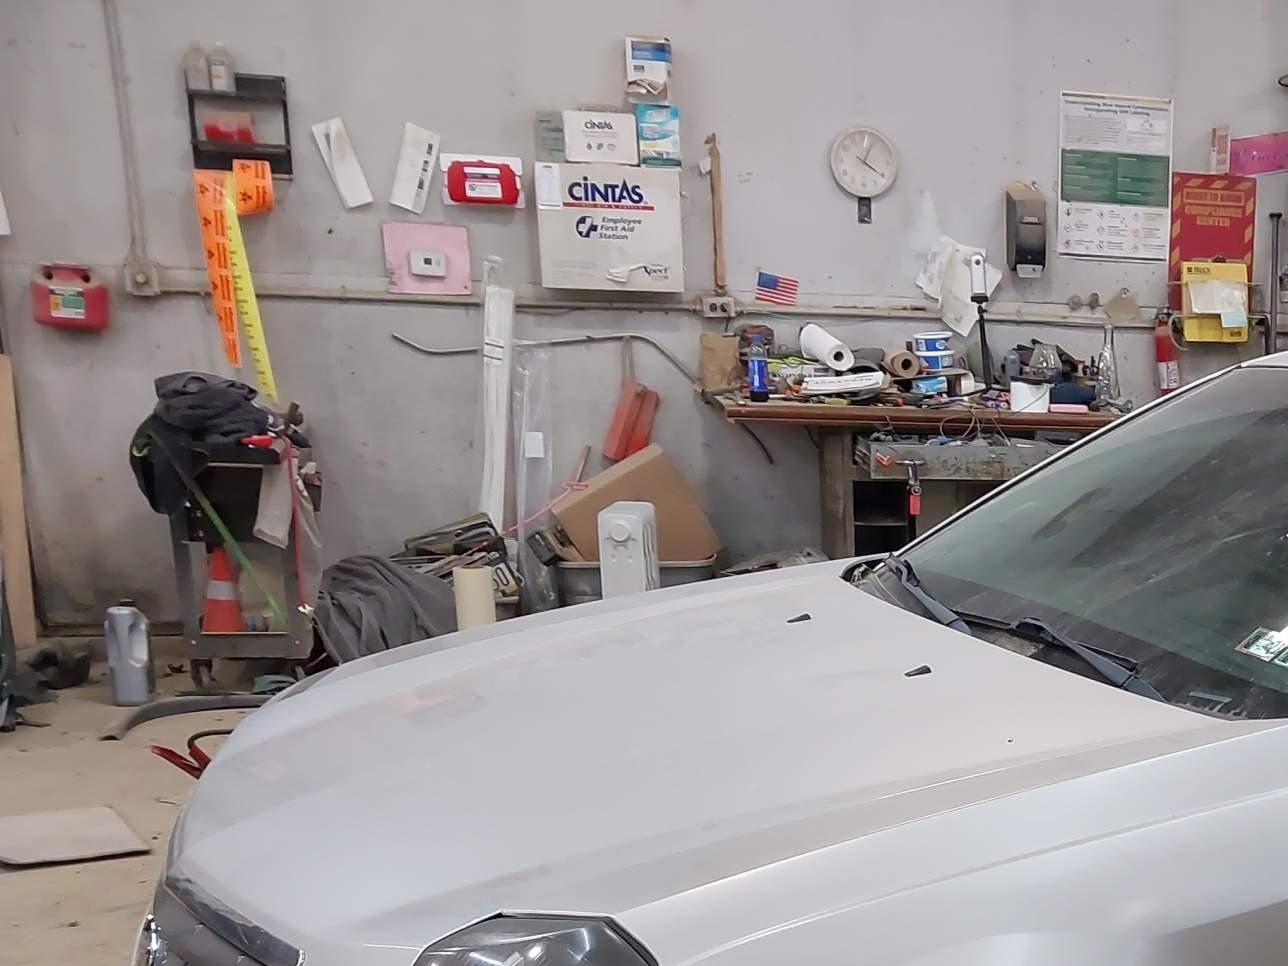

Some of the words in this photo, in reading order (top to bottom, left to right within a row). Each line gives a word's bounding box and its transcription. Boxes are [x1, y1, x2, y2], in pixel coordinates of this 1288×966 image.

[584, 119, 614, 130] CINTAS
[567, 176, 645, 205] CINTAS
[601, 216, 642, 226] Employee
[600, 225, 618, 233] First
[620, 225, 635, 234] Aid
[598, 232, 629, 241] Station
